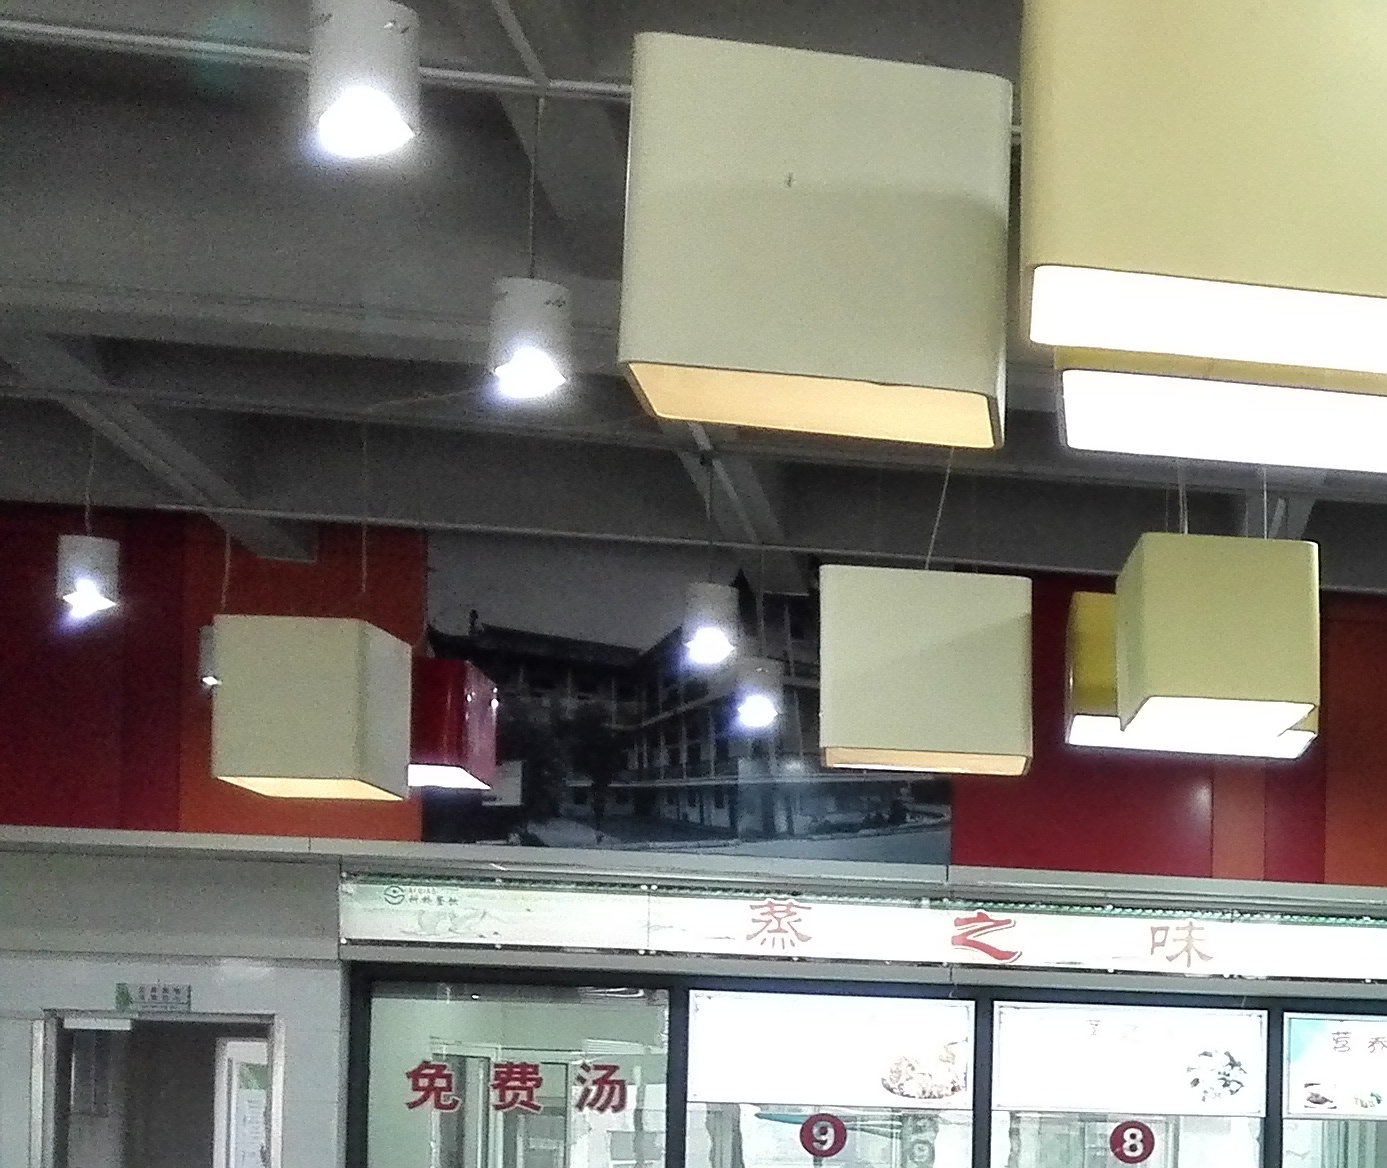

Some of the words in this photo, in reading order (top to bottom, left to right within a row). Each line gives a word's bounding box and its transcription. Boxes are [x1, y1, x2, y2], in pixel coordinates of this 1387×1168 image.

[745, 900, 1214, 968] 蒸之味
[405, 1060, 629, 1114] 免费汤
[812, 1120, 835, 1151] 9
[1122, 1127, 1145, 1158] 8
